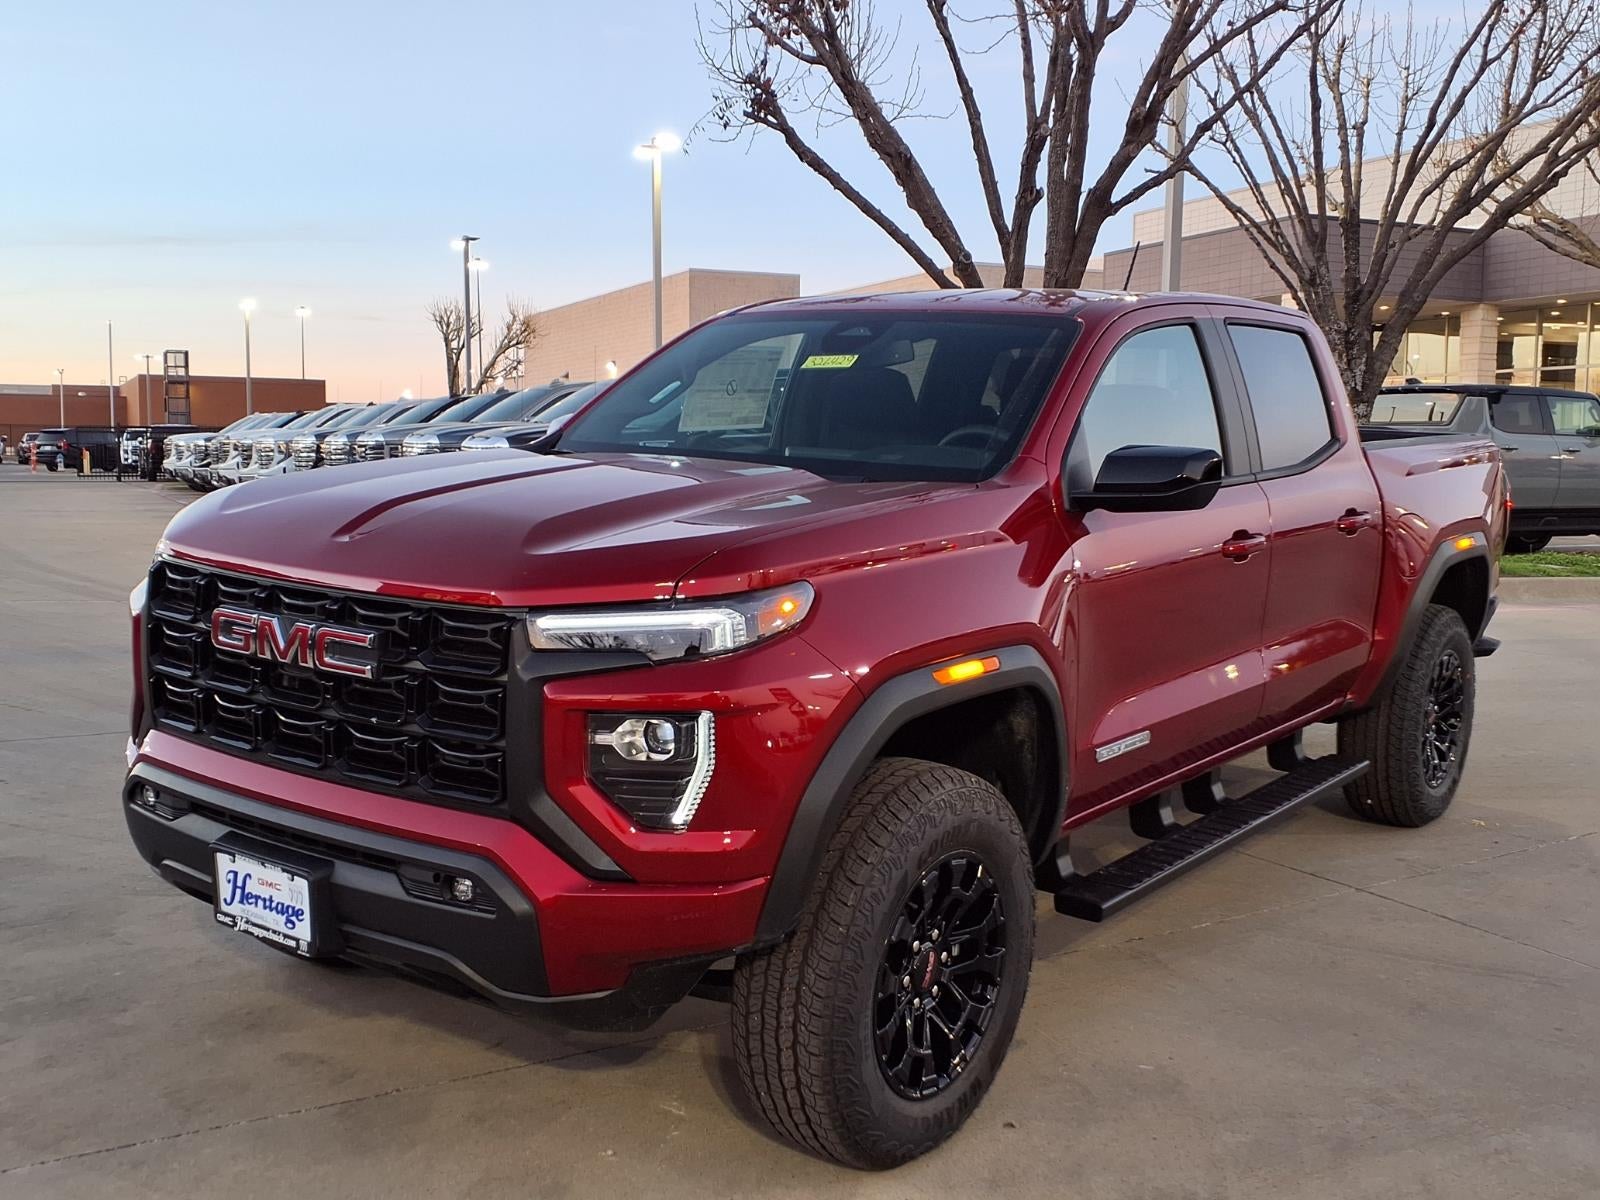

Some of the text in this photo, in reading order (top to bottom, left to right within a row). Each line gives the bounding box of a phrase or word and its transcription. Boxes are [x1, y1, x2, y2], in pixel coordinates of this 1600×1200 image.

[211, 606, 375, 679] GMC
[223, 869, 305, 930] Heritage
[257, 878, 282, 891] GMC
